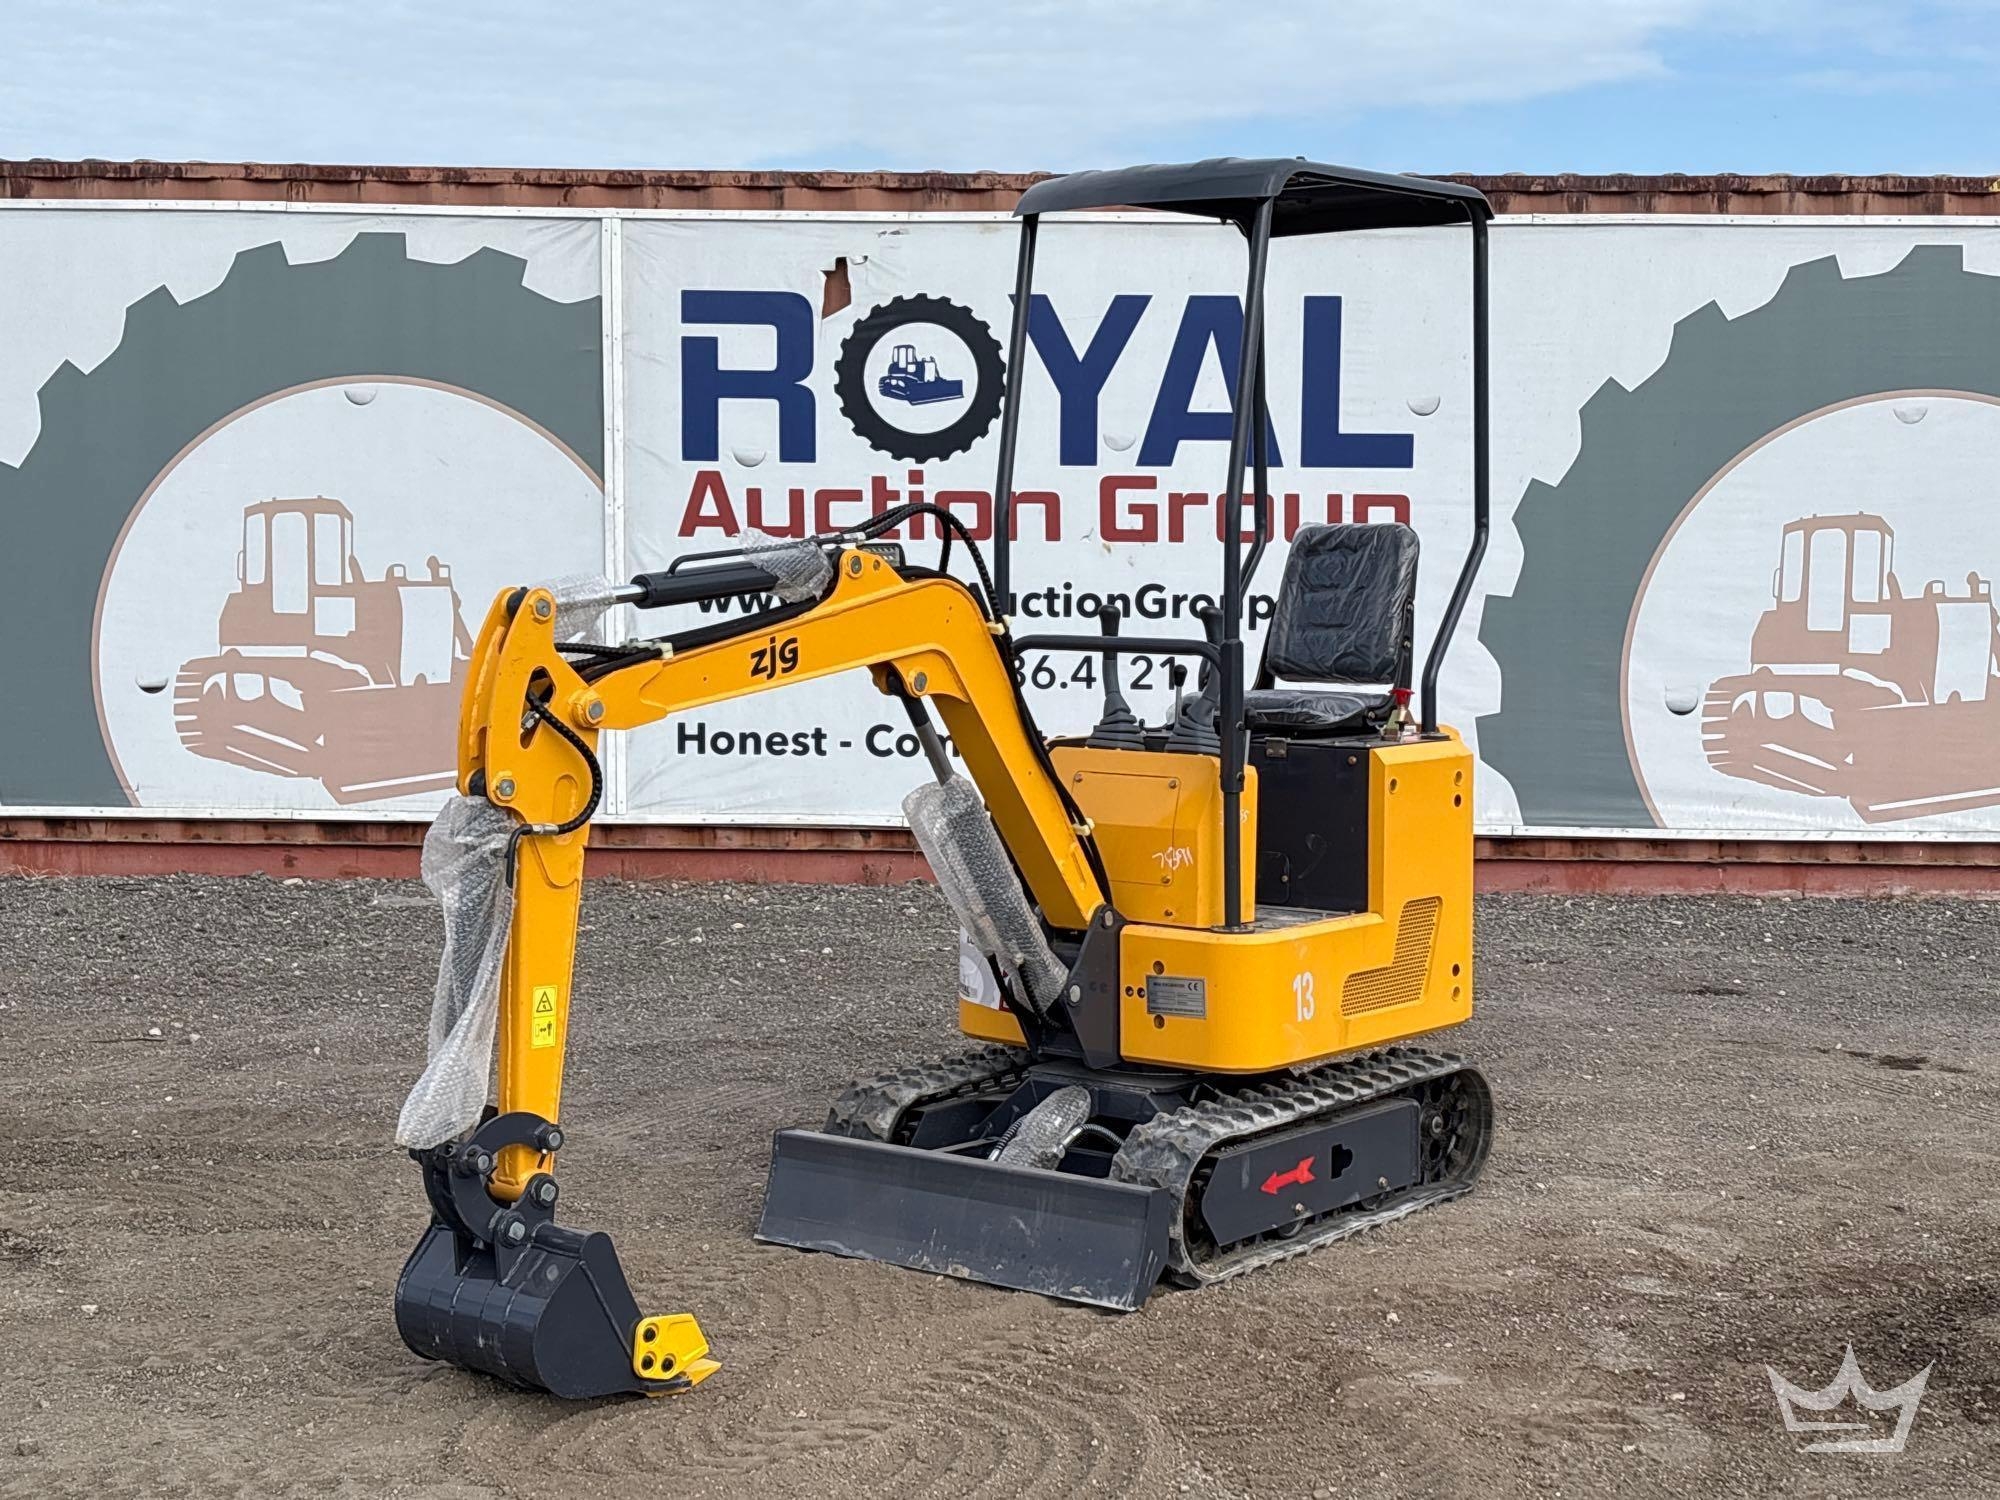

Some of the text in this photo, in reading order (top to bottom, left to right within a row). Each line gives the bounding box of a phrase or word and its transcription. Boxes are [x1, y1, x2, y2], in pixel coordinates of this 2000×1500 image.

[681, 289, 1414, 468] ROYAL
[678, 470, 1062, 542] Auction
[676, 722, 828, 757] Honest
[1292, 971, 1315, 1022] 13
